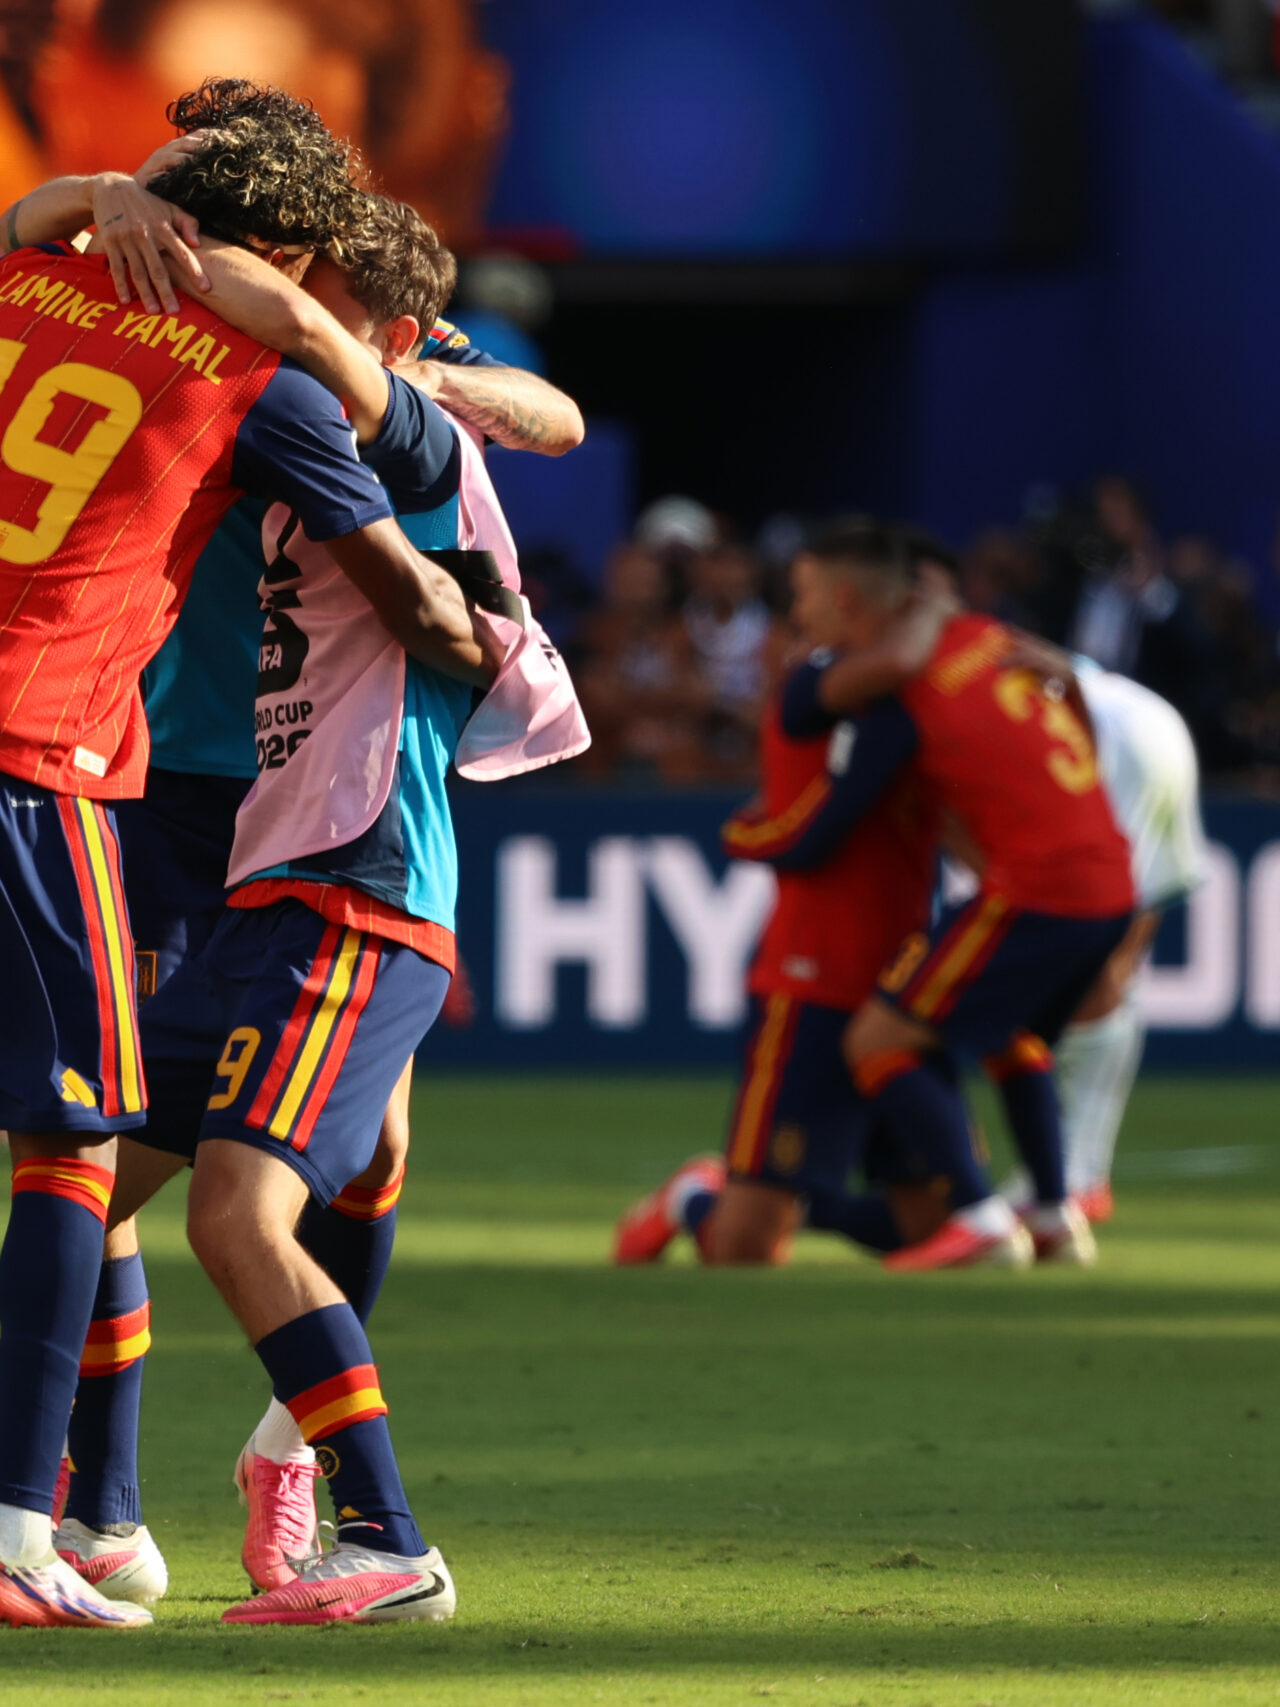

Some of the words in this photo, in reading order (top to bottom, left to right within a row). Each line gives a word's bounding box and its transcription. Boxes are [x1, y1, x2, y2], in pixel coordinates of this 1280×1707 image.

[112, 310, 232, 386] YAMAL
[274, 700, 314, 726] CUP
[206, 1026, 262, 1112] 9
